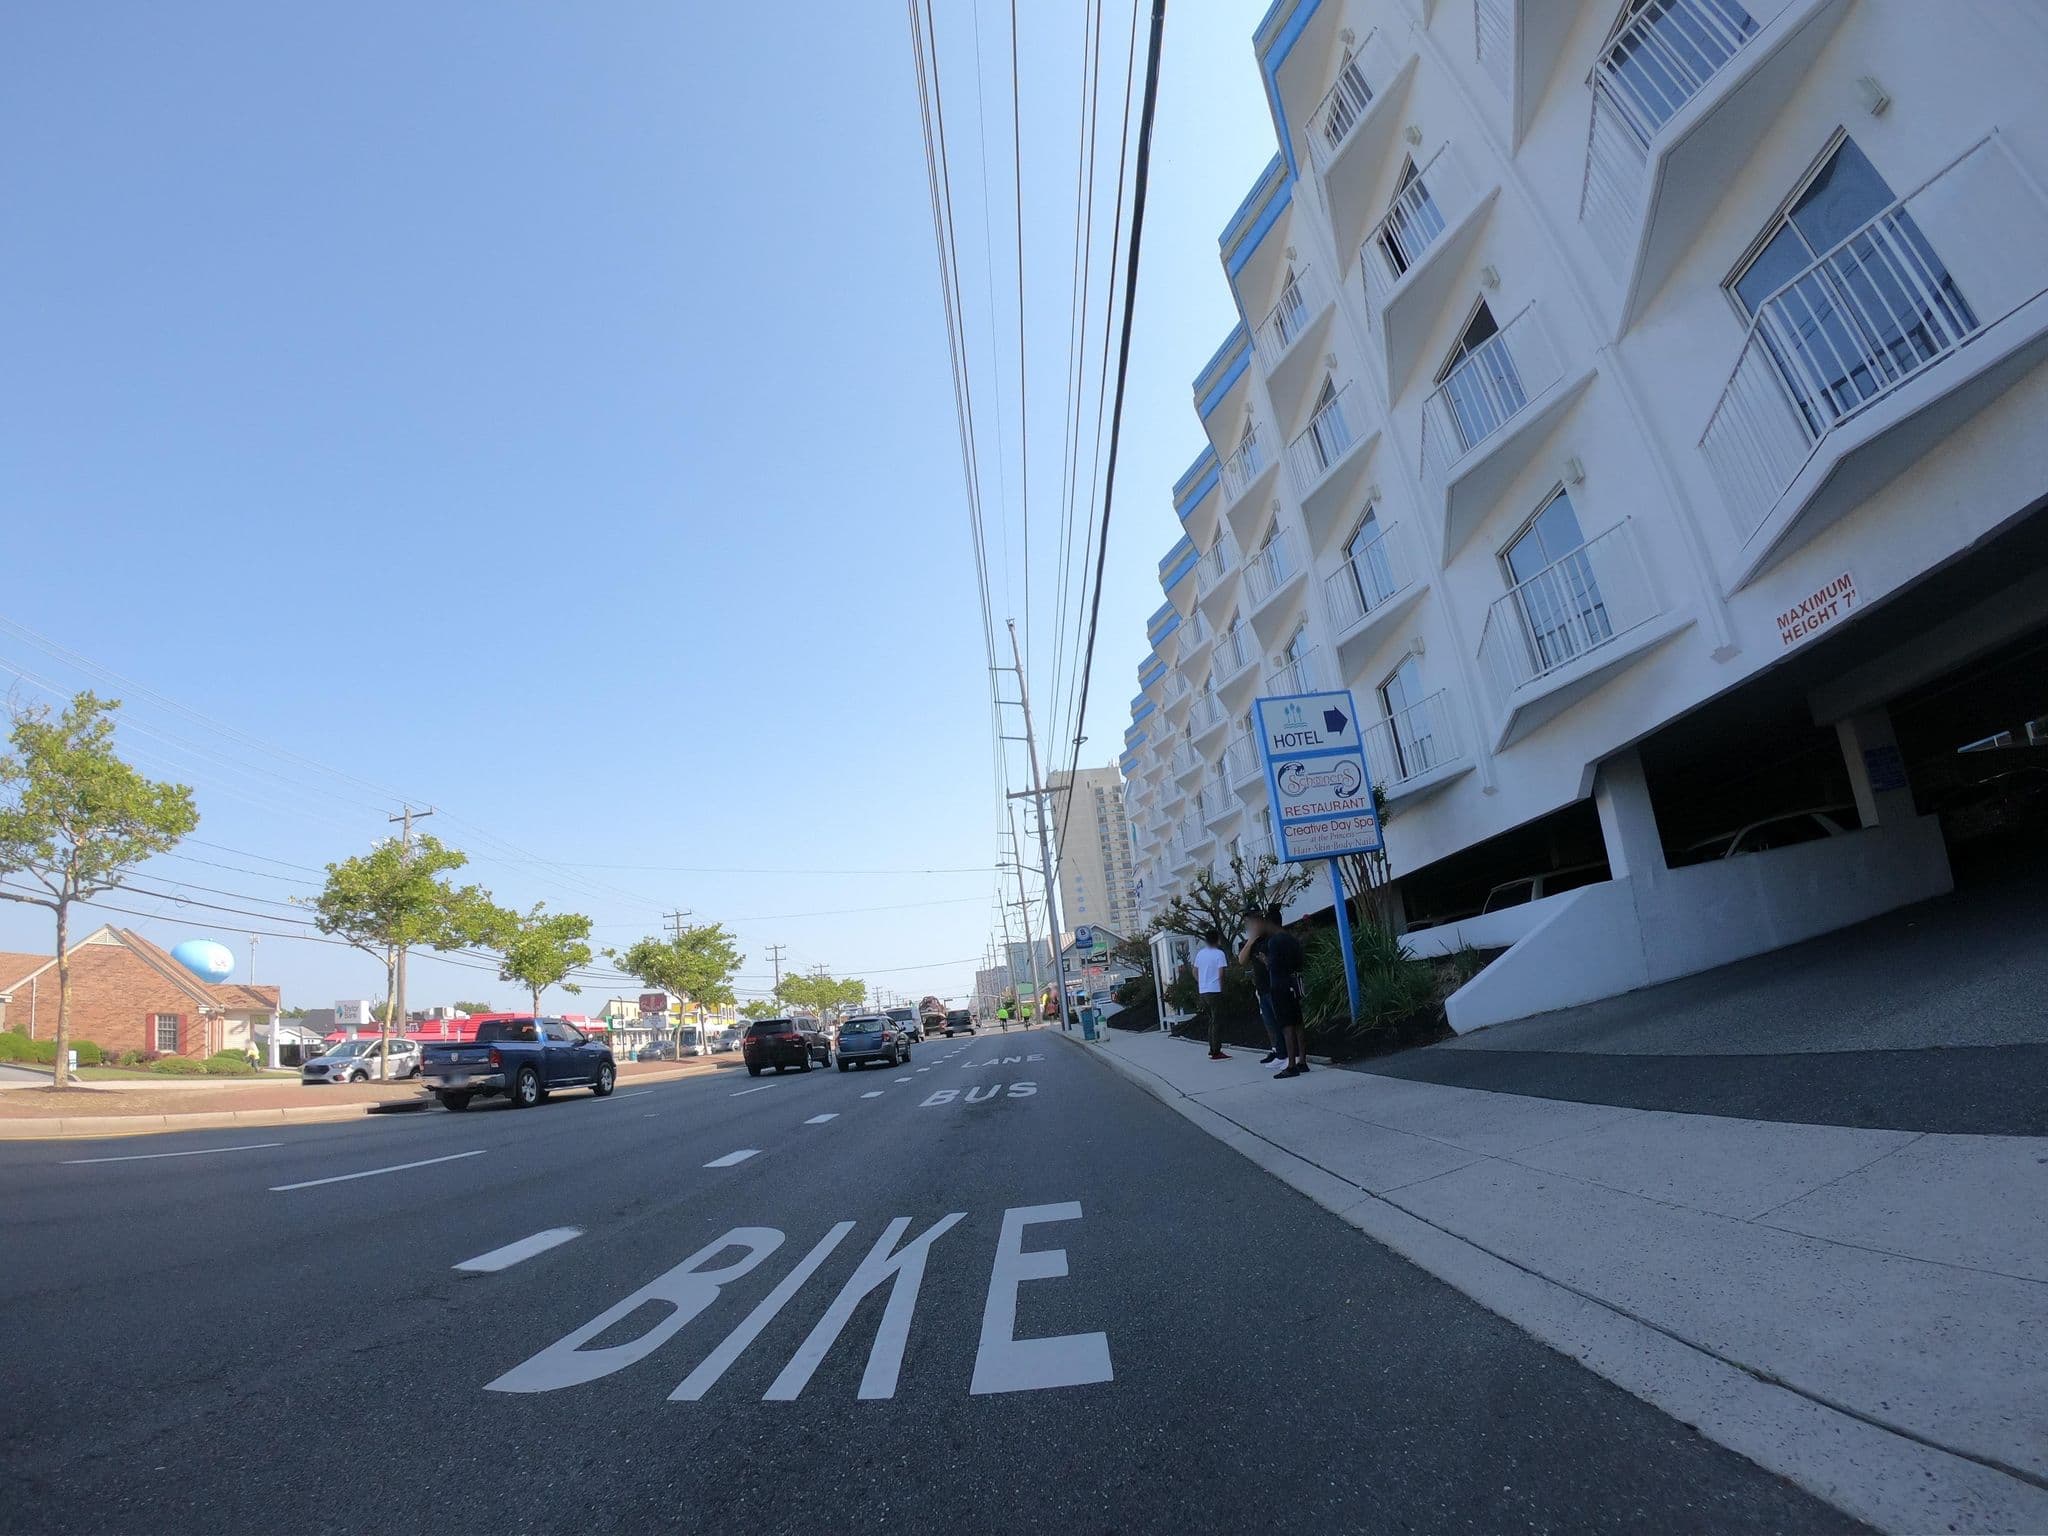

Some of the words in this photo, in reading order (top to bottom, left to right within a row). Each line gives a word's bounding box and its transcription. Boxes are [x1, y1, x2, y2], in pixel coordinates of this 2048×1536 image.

[1776, 573, 1852, 630] MAXIMUM
[1782, 601, 1838, 645] HEIGHT
[1274, 731, 1324, 749] HOTEL
[1285, 798, 1366, 817] RESTAURANT
[1284, 822, 1328, 837] Creative
[1331, 819, 1351, 831] Day
[1354, 817, 1375, 830] Spa
[960, 1054, 1046, 1068] LANE
[918, 1082, 1038, 1107] BUS
[482, 1200, 1114, 1401] BIKE
